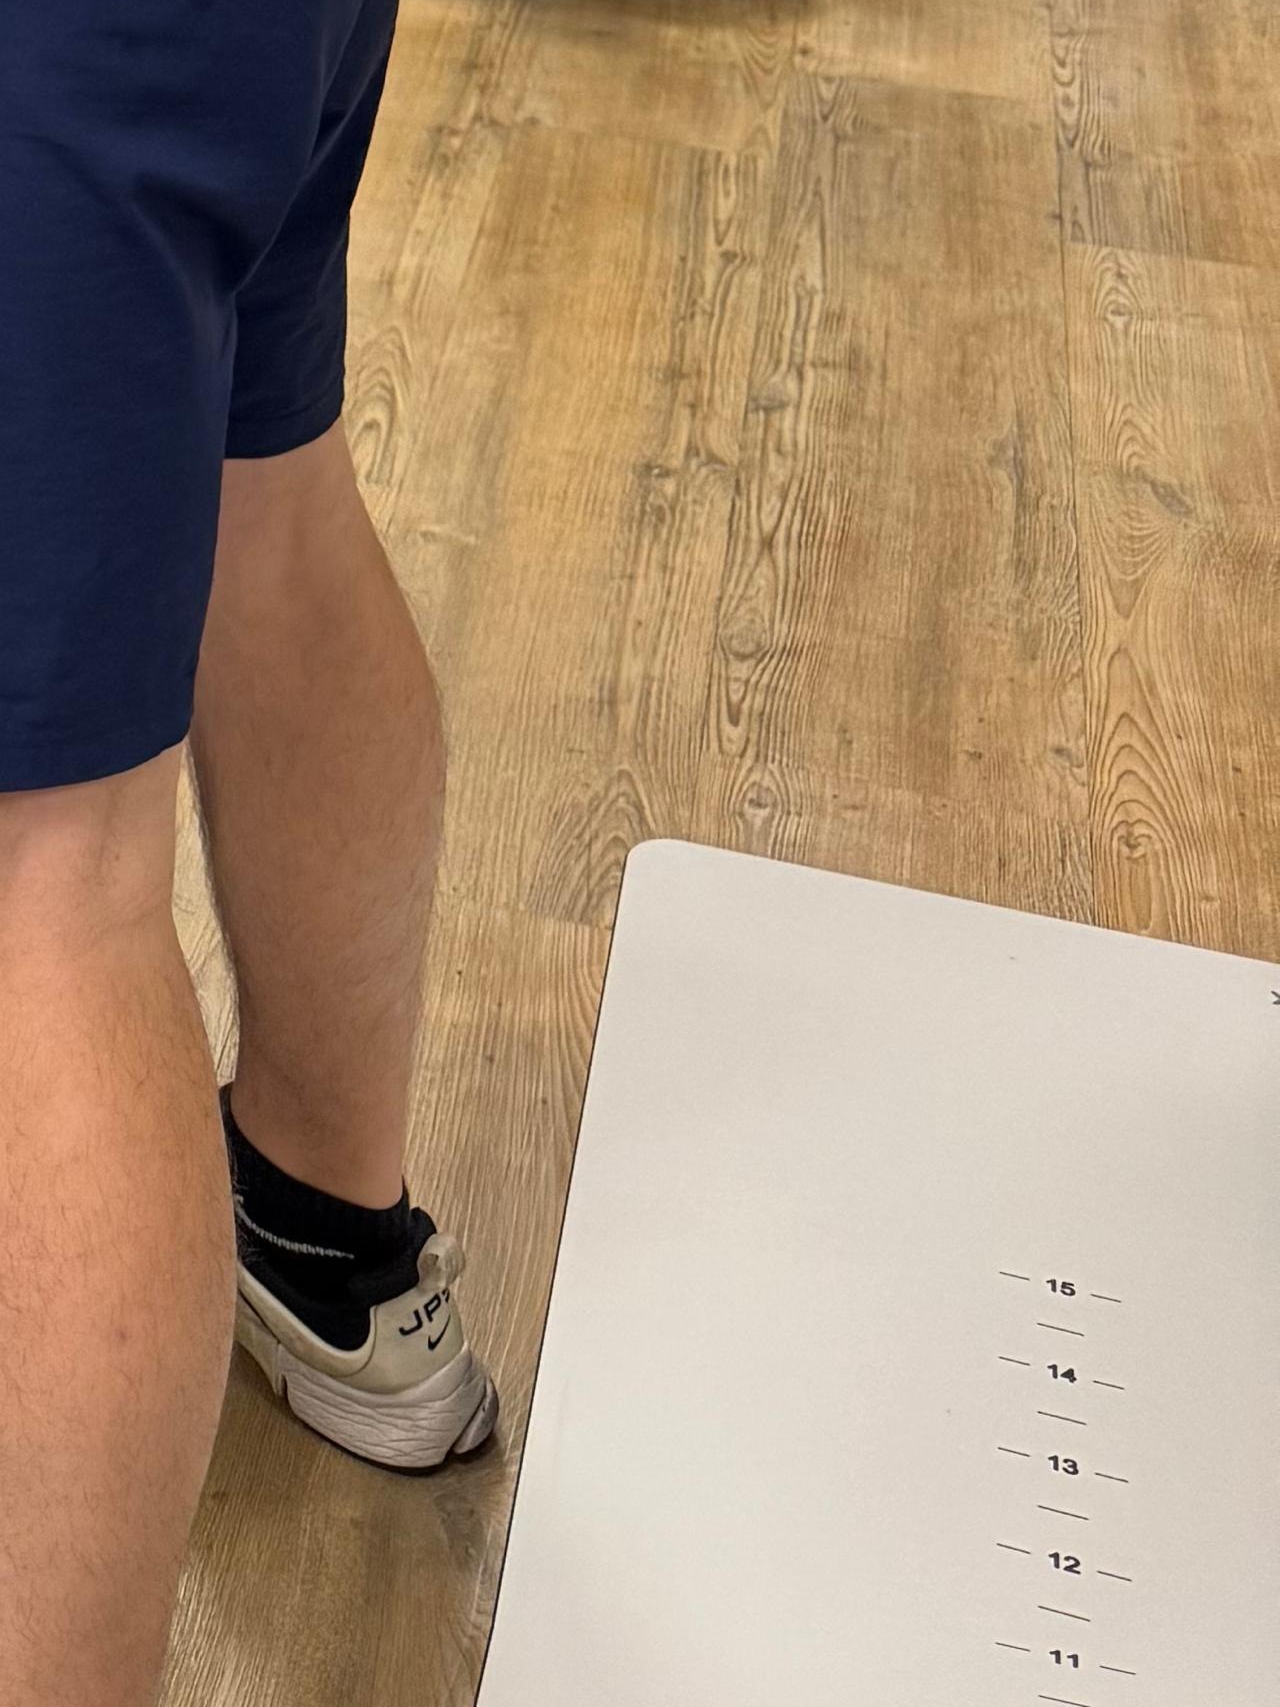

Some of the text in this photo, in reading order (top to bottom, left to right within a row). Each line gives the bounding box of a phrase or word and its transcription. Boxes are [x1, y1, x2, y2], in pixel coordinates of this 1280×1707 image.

[1046, 1278, 1076, 1297] 15
[1047, 1364, 1077, 1383] 14
[1048, 1455, 1079, 1476] 13
[1048, 1552, 1082, 1575] 12
[1049, 1649, 1079, 1668] 11
